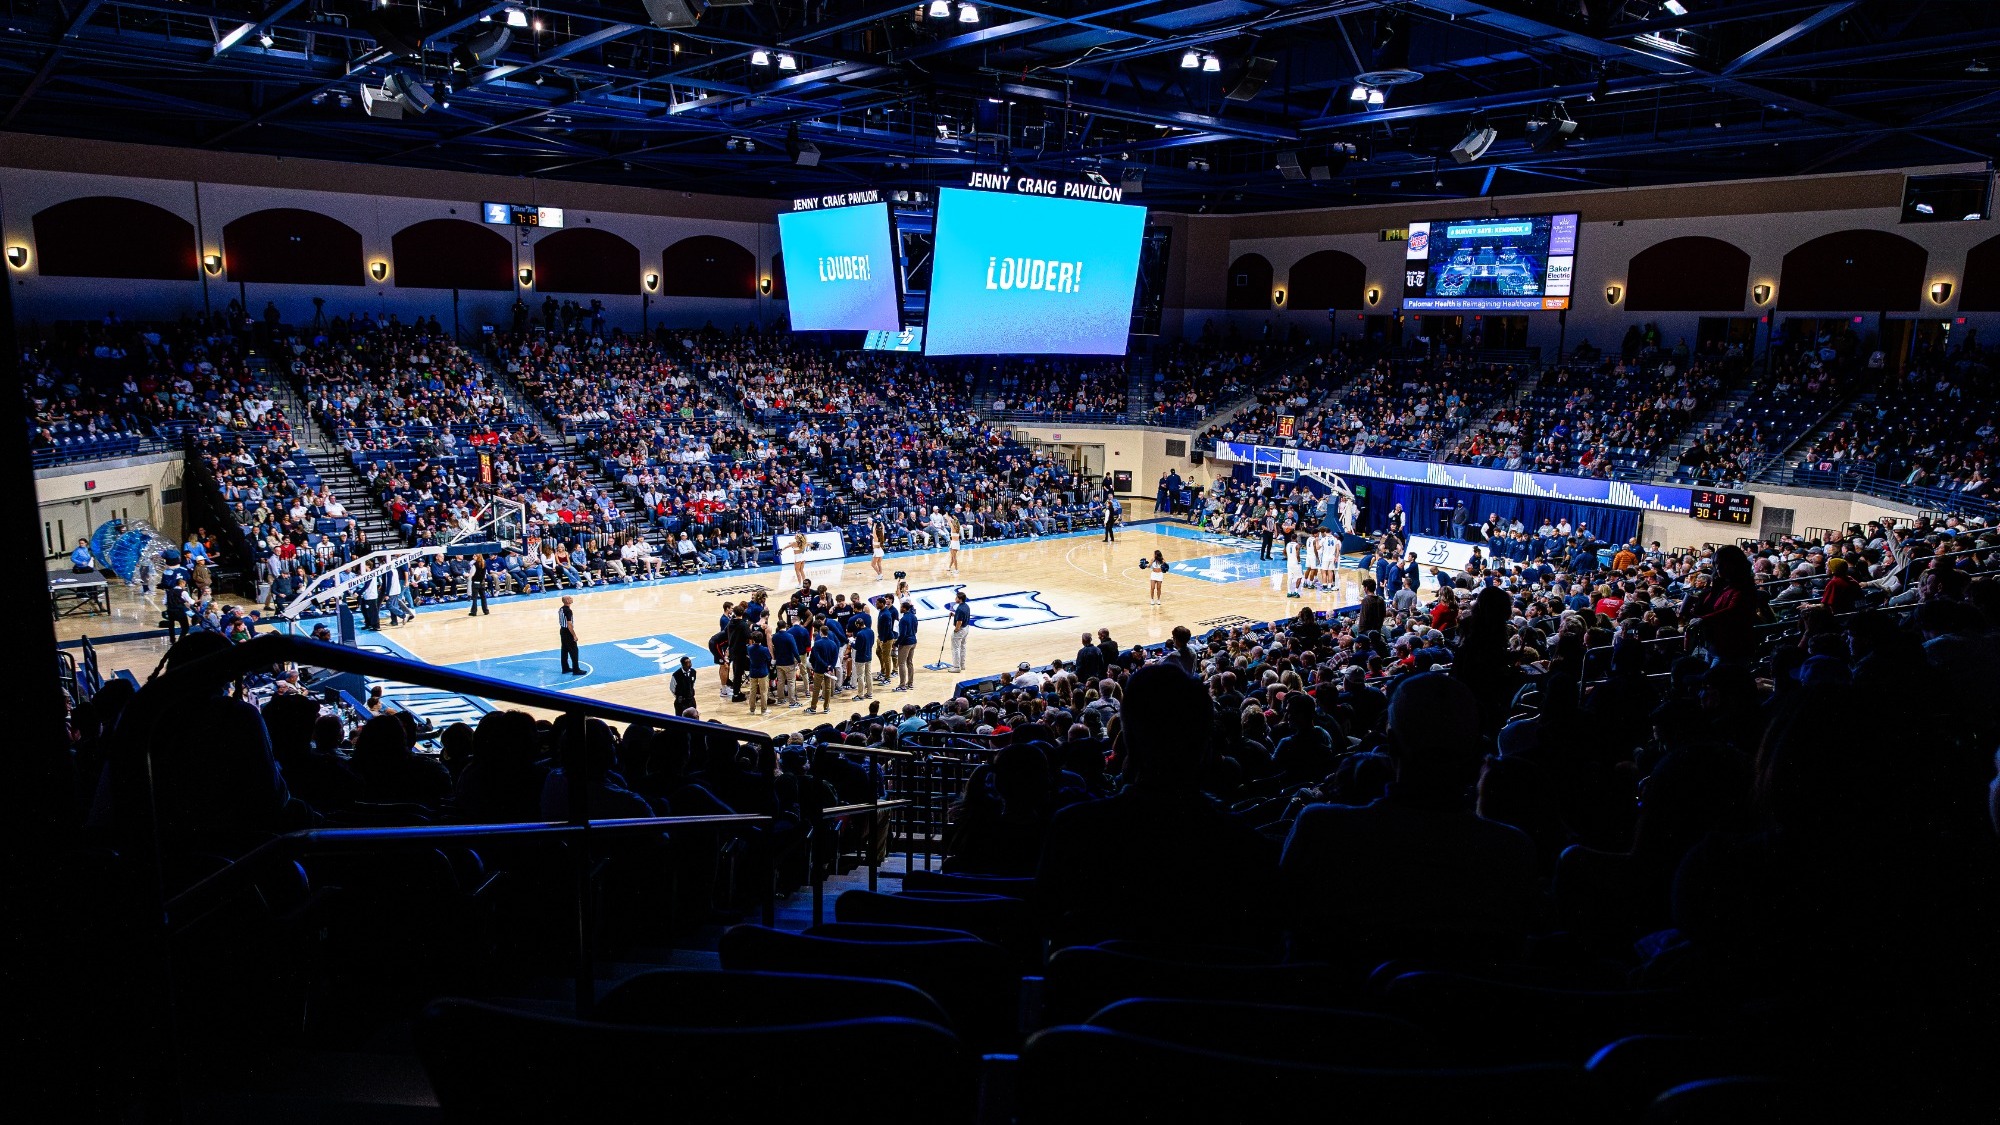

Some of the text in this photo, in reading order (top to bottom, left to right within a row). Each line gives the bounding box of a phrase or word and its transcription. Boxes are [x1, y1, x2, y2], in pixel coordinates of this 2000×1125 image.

[968, 171, 1122, 202] JENNY CRAIG PAVILION
[793, 190, 878, 211] JENNY CRAIG PAVILION
[818, 254, 871, 282] LOUDER!
[985, 256, 1083, 294] LOUDER!
[1462, 300, 1500, 309] Reimagining
[1280, 424, 1291, 436] 30
[1702, 492, 1725, 504] 3:10
[1697, 508, 1709, 518] 30
[1733, 512, 1747, 522] 41
[348, 568, 383, 588] UNIVERSITY
[394, 557, 408, 567] SAN
